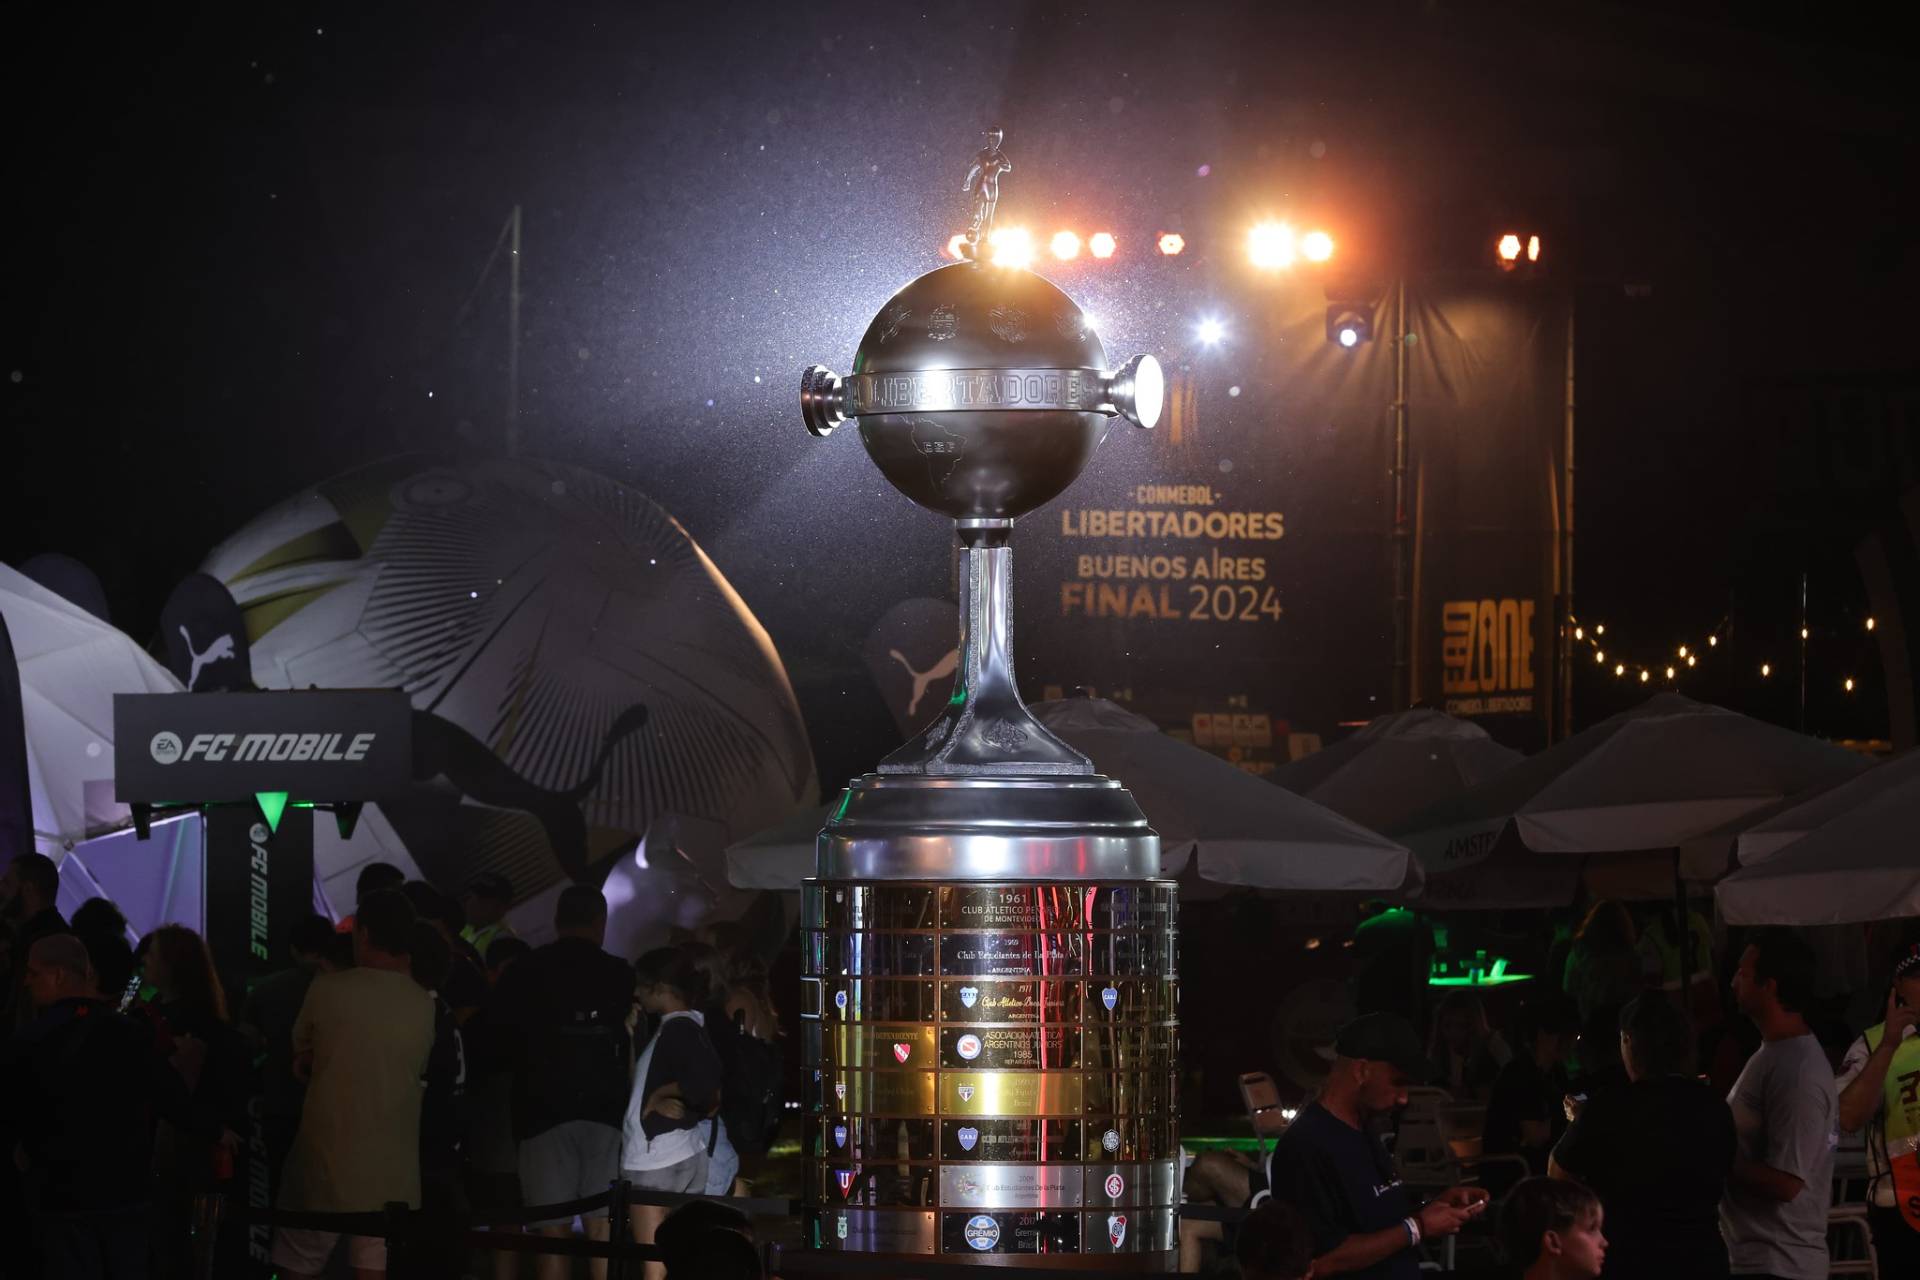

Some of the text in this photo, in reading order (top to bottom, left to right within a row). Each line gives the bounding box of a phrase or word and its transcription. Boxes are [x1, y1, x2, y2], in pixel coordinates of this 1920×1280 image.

[1136, 485, 1215, 505] CONMEBOL
[1061, 509, 1284, 540] LIBERTADORES
[1078, 547, 1267, 581] BUENOS AIRES
[1060, 582, 1283, 621] FINAL 2024
[182, 733, 235, 761] FC
[232, 733, 376, 761] MOBILE
[251, 842, 268, 875] FC
[999, 894, 1027, 904] 1961
[250, 873, 268, 960] MOBILE
[961, 906, 983, 914] CLUB
[984, 906, 1024, 914] ATLETICO
[957, 951, 976, 959] Club
[978, 950, 1021, 960] Estudiantes
[1022, 951, 1032, 959] de
[984, 1040, 1031, 1049] ARGENTINOS
[1013, 1050, 1033, 1058] 1985
[840, 1172, 850, 1189] U
